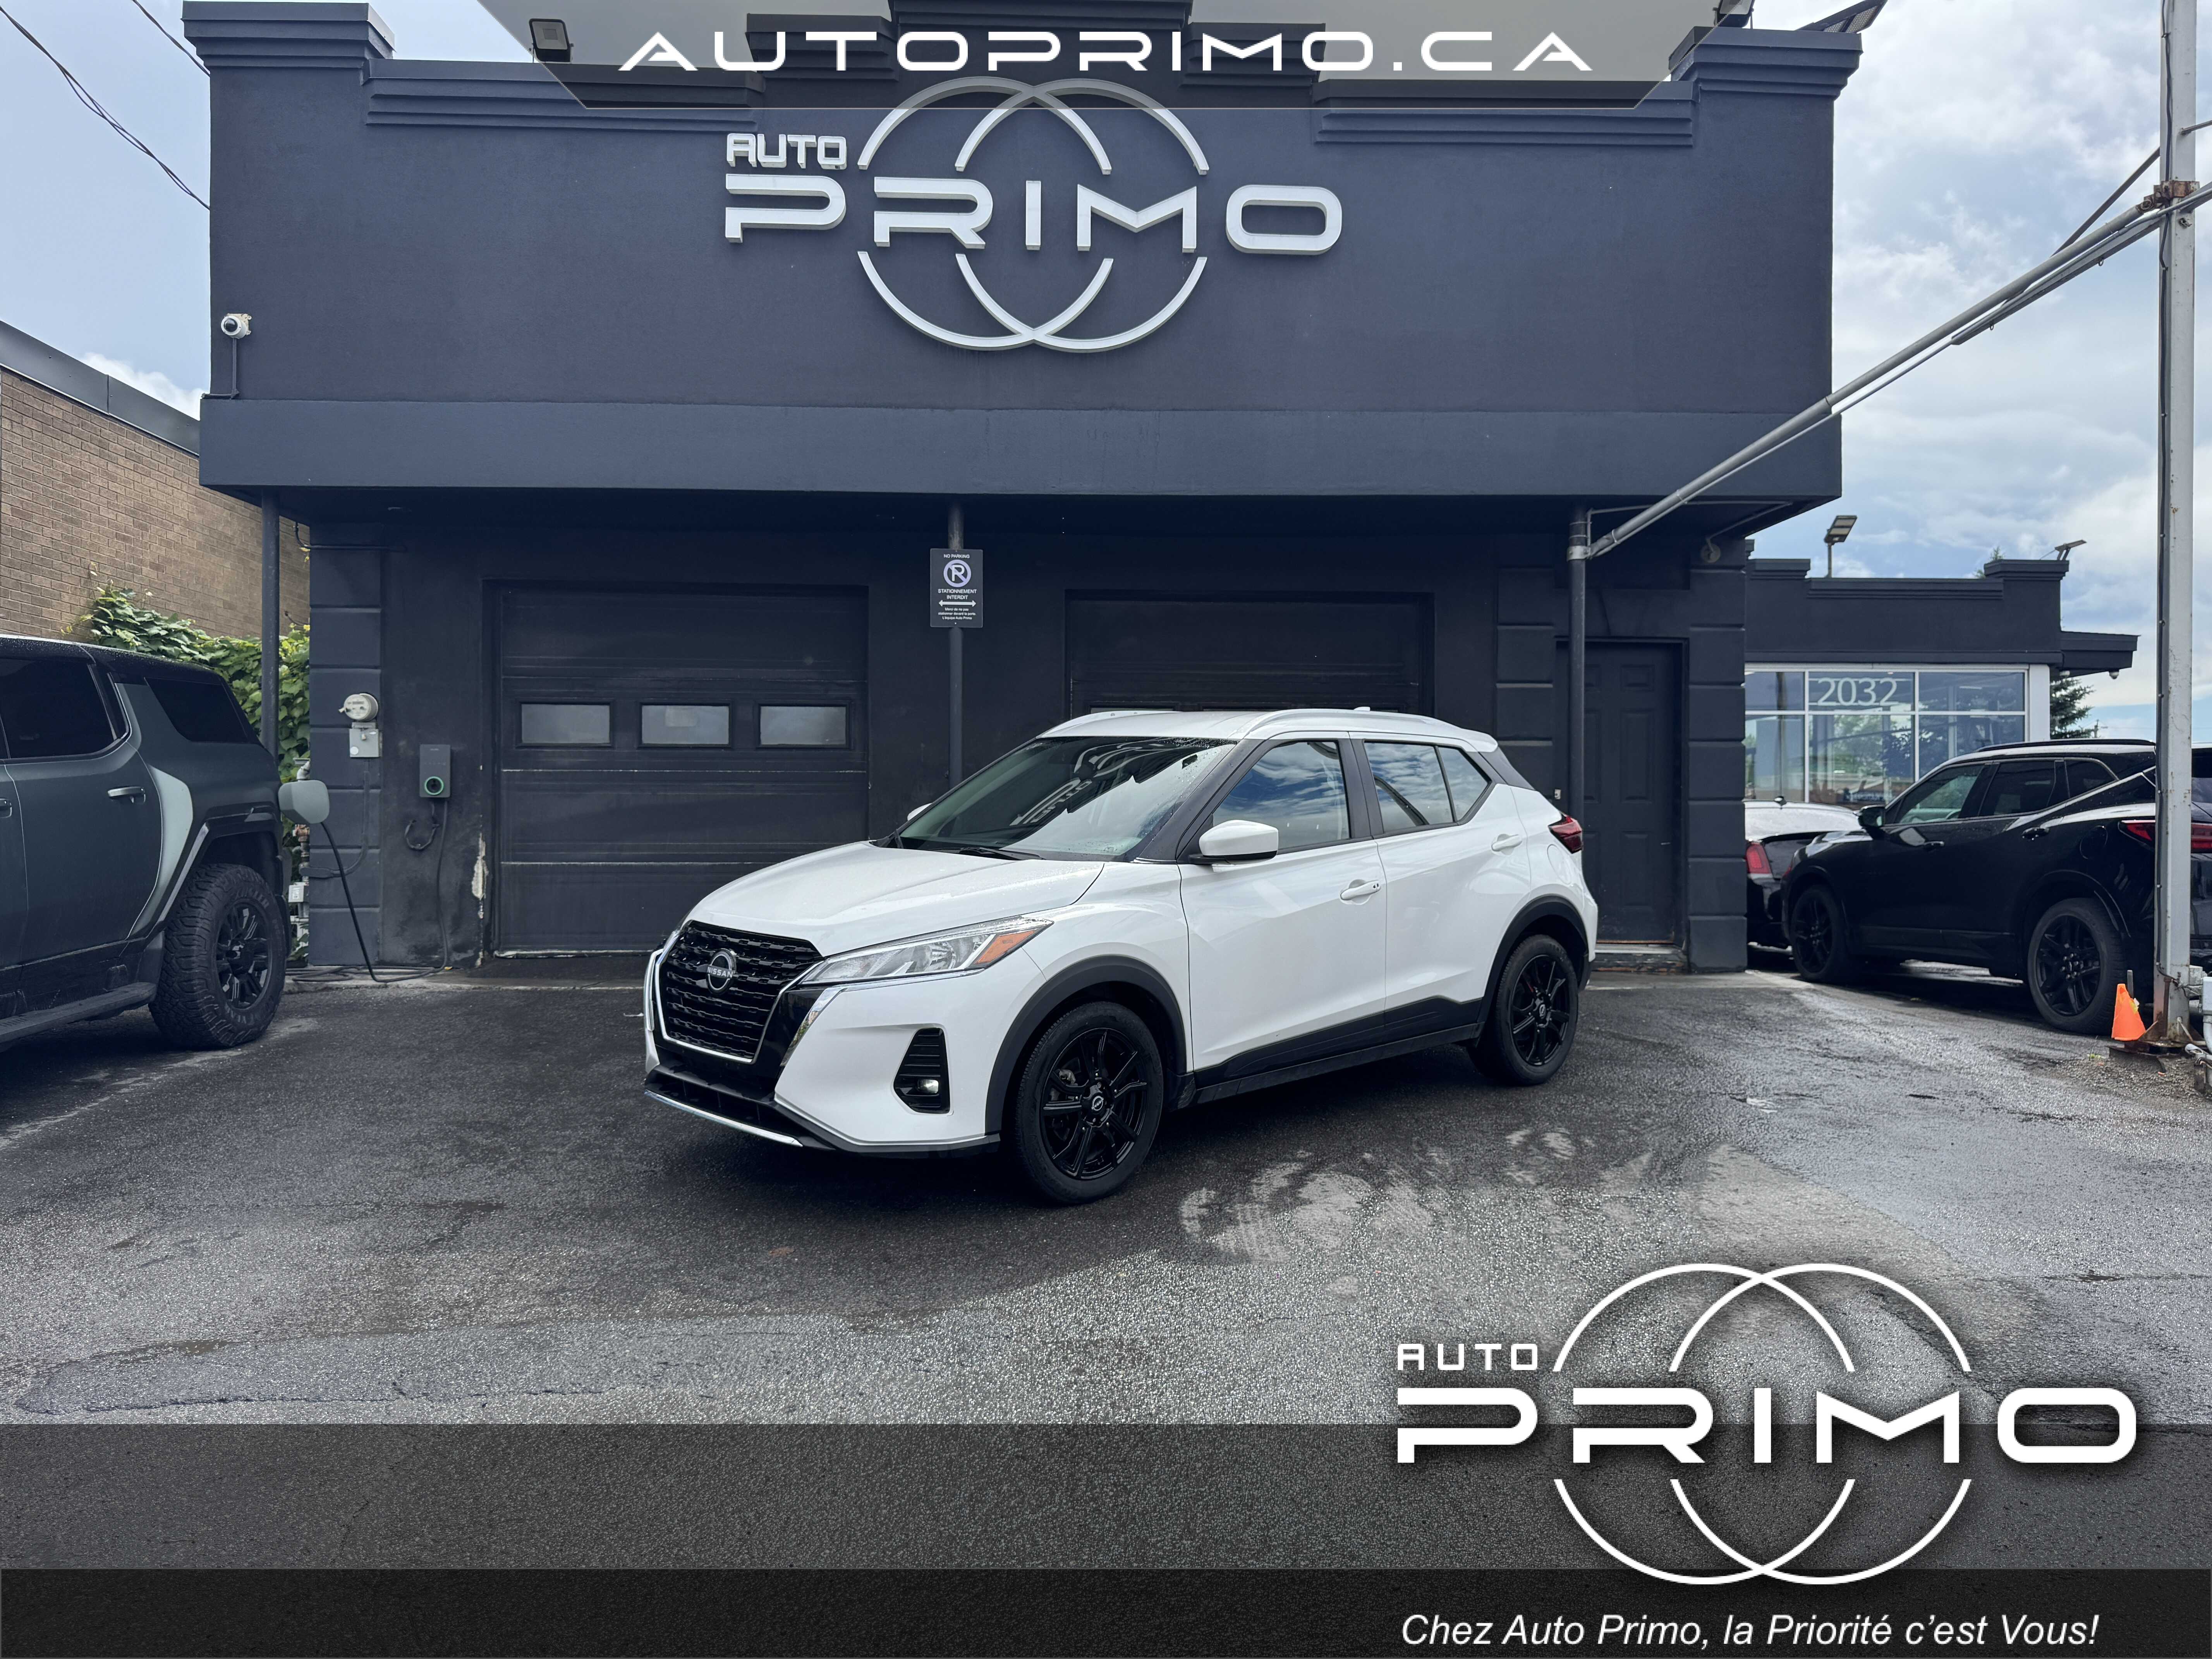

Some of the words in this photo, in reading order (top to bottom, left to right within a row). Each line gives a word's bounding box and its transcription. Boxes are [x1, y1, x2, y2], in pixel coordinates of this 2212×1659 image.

[726, 133, 847, 170] AUTO
[725, 173, 1343, 256] PRIMO
[1816, 677, 1899, 706] 2032
[707, 966, 733, 978] NISSAN
